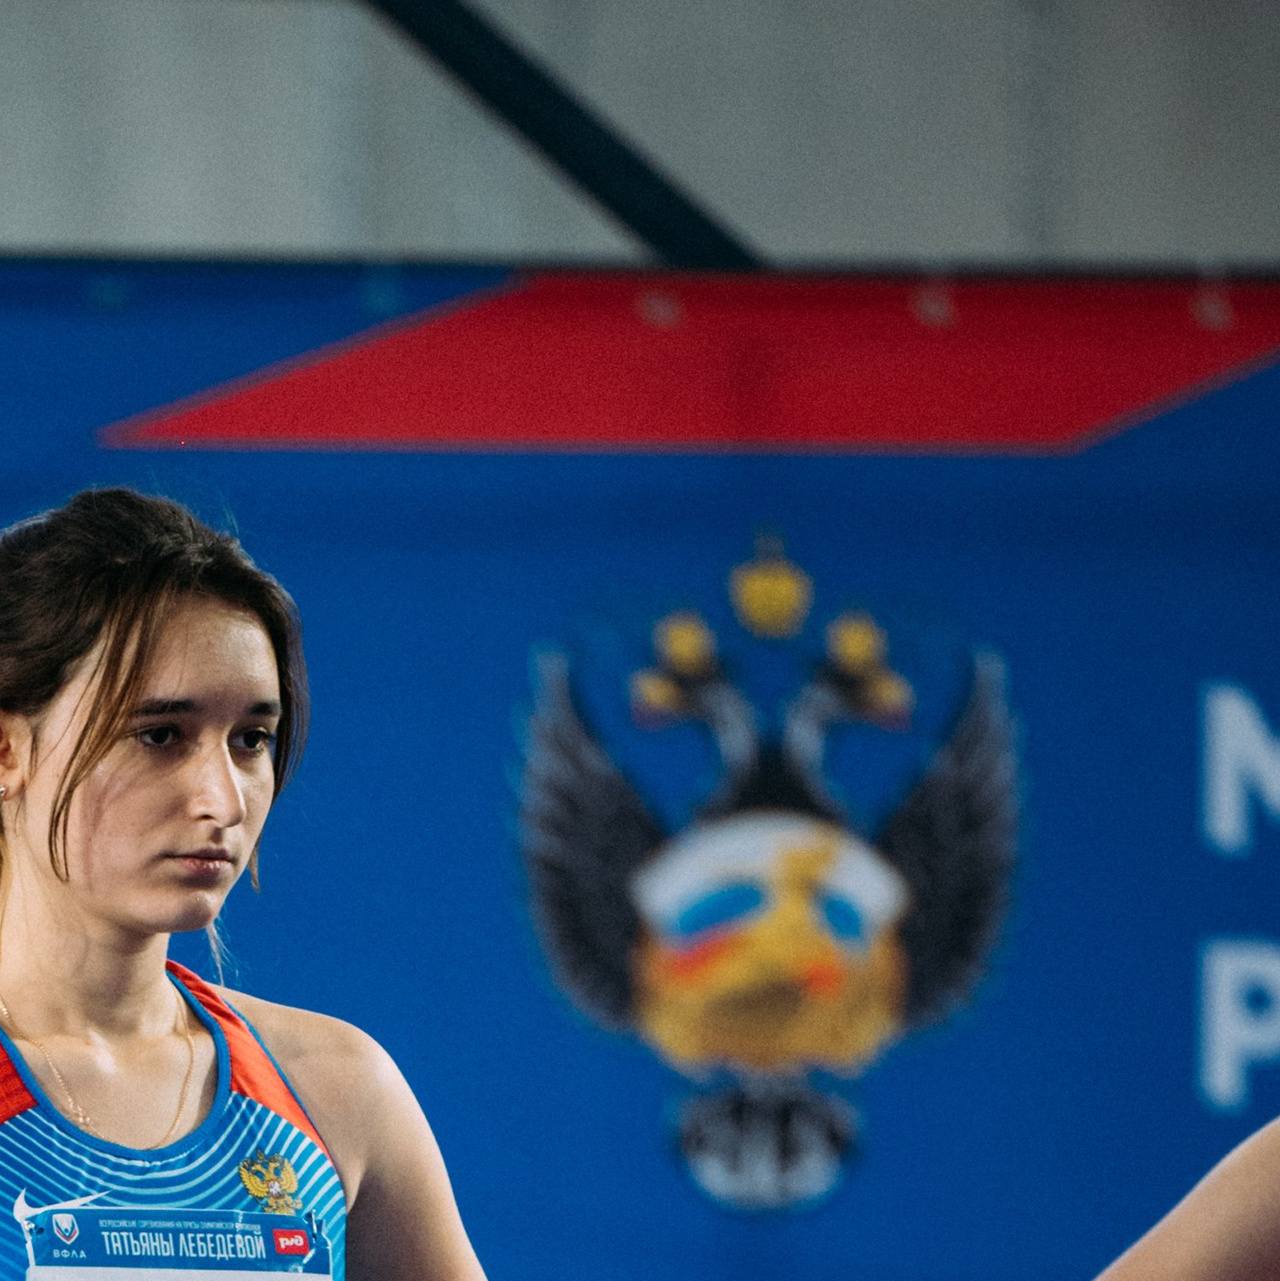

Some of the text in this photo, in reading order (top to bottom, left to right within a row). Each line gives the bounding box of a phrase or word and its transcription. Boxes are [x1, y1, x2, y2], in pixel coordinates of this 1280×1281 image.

[53, 1249, 86, 1258] ВФЛА
[101, 1230, 266, 1260] ТАТЬЯНЫ ЛЕБЕДЕВОЙ
